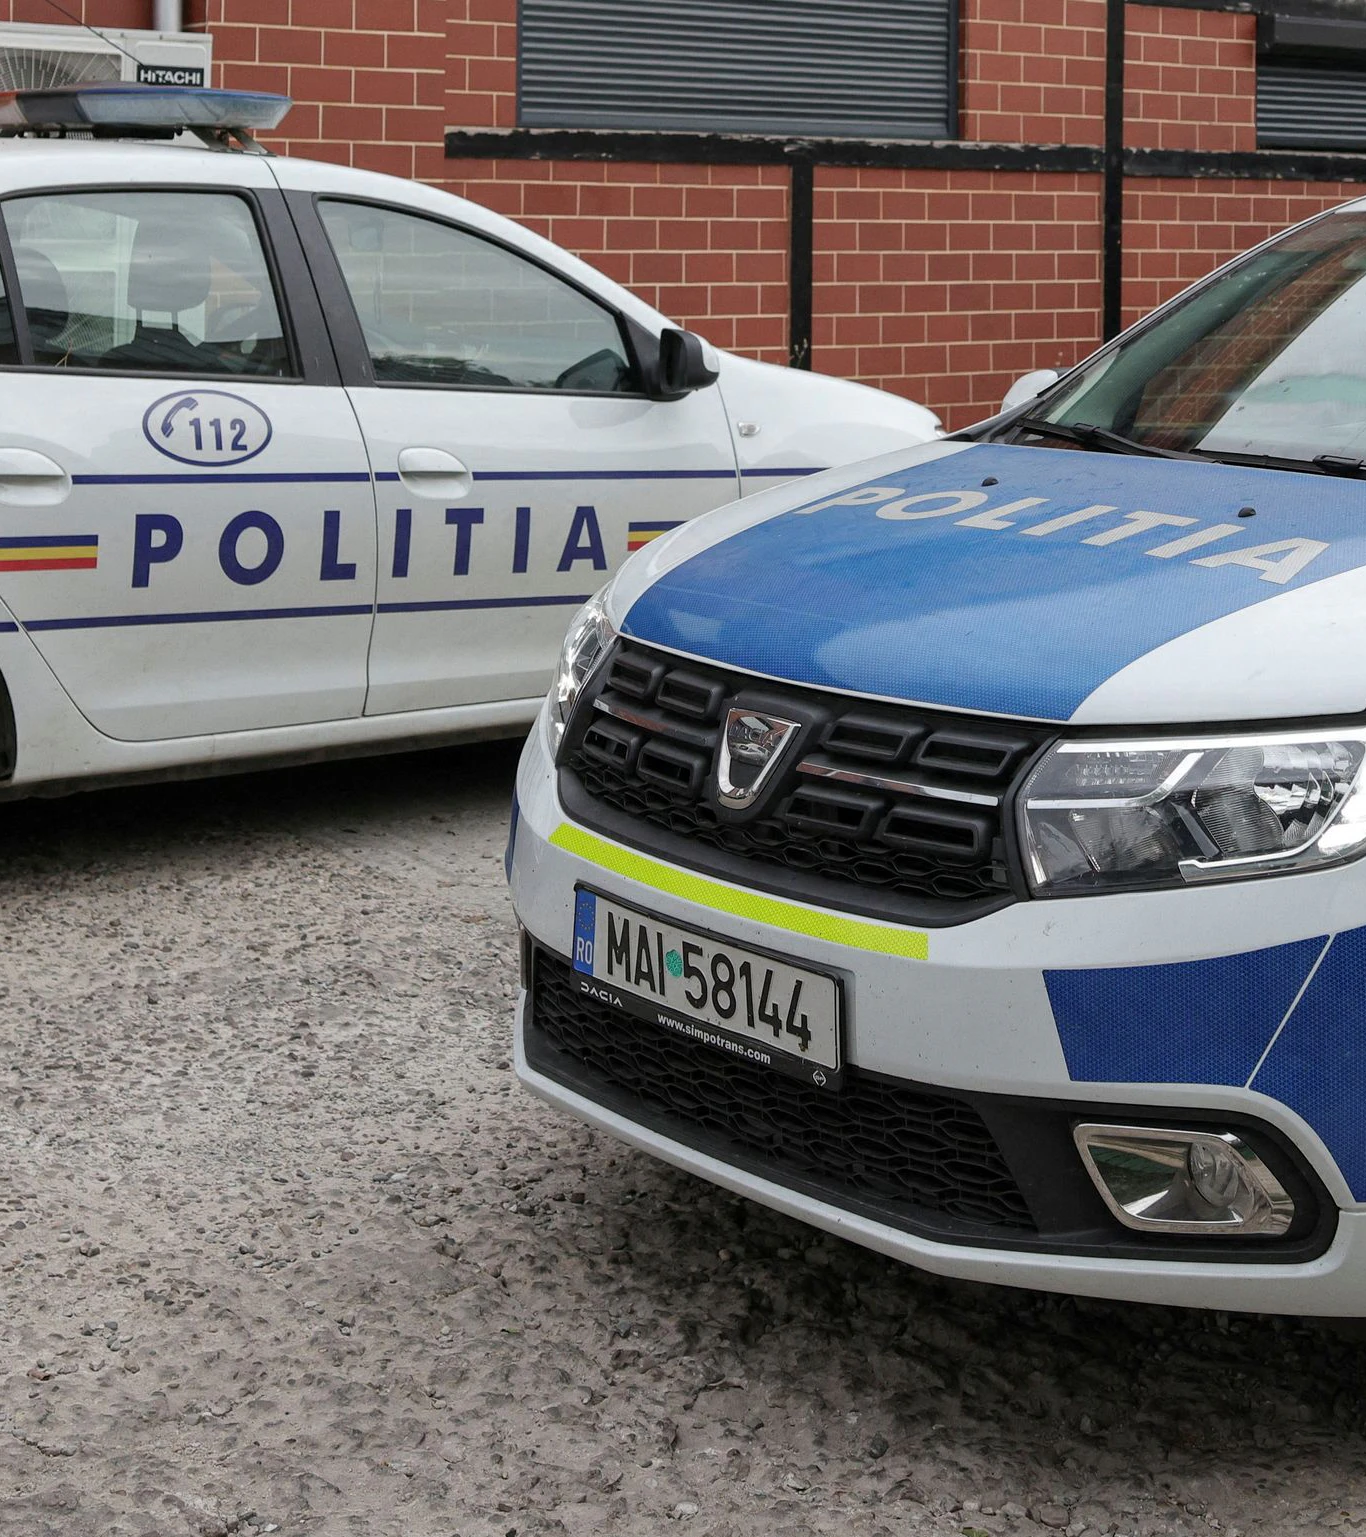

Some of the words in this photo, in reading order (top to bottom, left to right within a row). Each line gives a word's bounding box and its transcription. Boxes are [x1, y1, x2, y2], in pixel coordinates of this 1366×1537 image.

[140, 69, 201, 85] HITACHI
[188, 416, 248, 453] 112
[131, 505, 608, 589] POLITIA
[793, 486, 1331, 586] POLITIA
[576, 937, 593, 966] RO
[580, 981, 624, 1008] DACIA
[606, 911, 666, 997] MAI
[681, 940, 812, 1050] 58144
[657, 1013, 771, 1066] www.simpotrans.com
